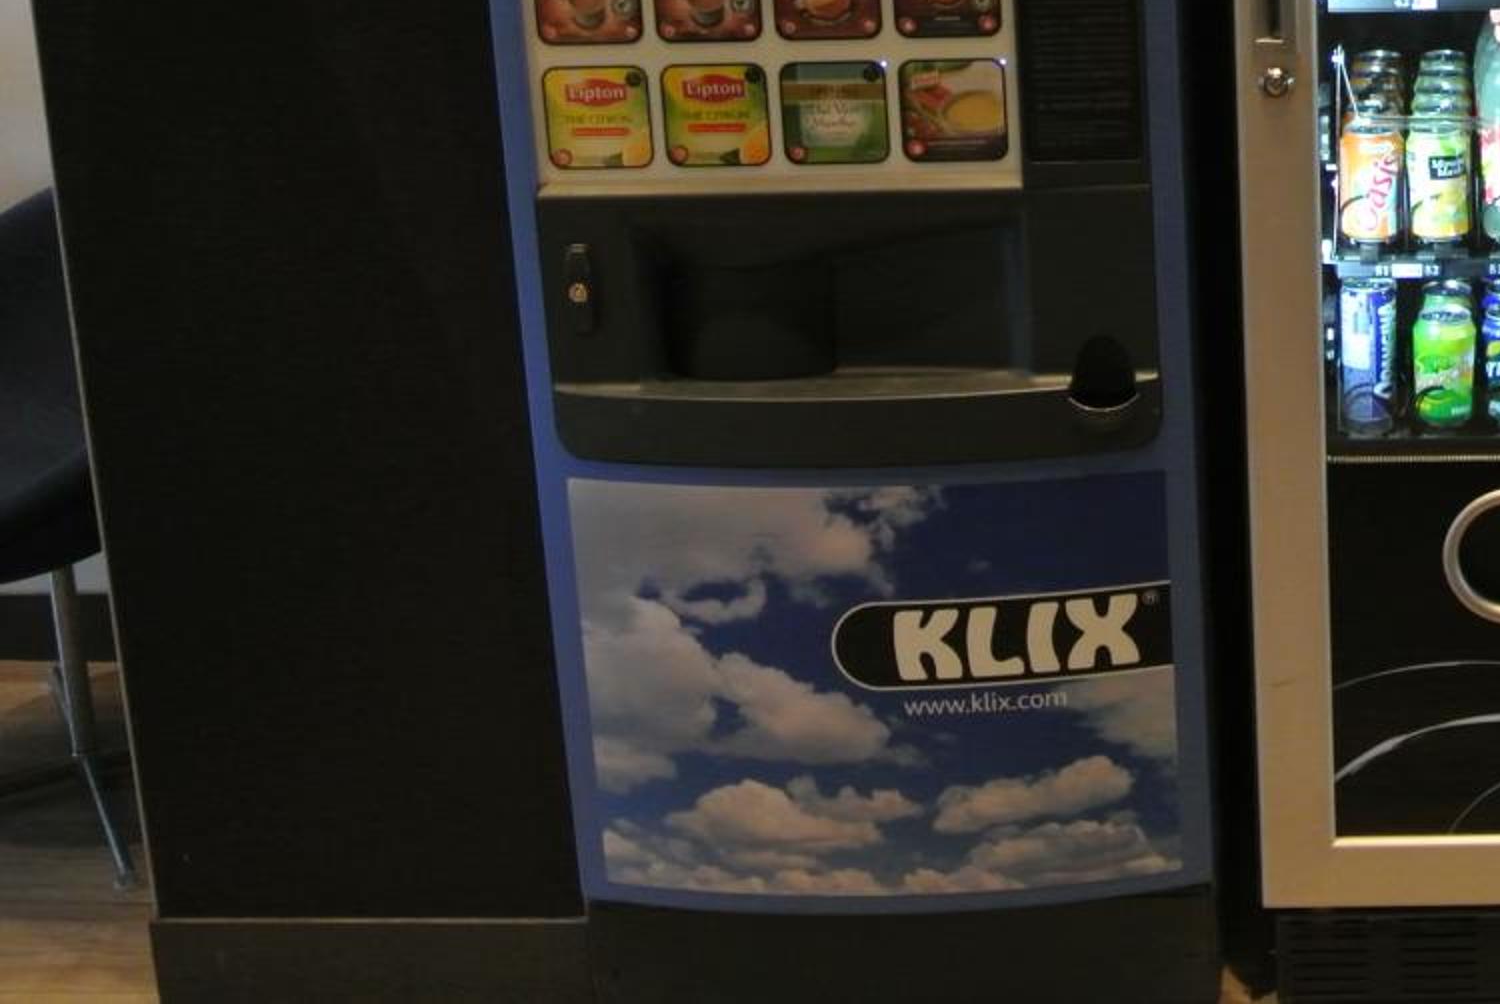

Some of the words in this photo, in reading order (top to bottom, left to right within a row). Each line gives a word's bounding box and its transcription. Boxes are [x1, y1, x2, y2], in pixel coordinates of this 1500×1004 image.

[568, 85, 625, 100] Lipton
[685, 80, 742, 97] Lipton
[893, 593, 1141, 682] KLIX
[904, 690, 1068, 717] www.klix.com
